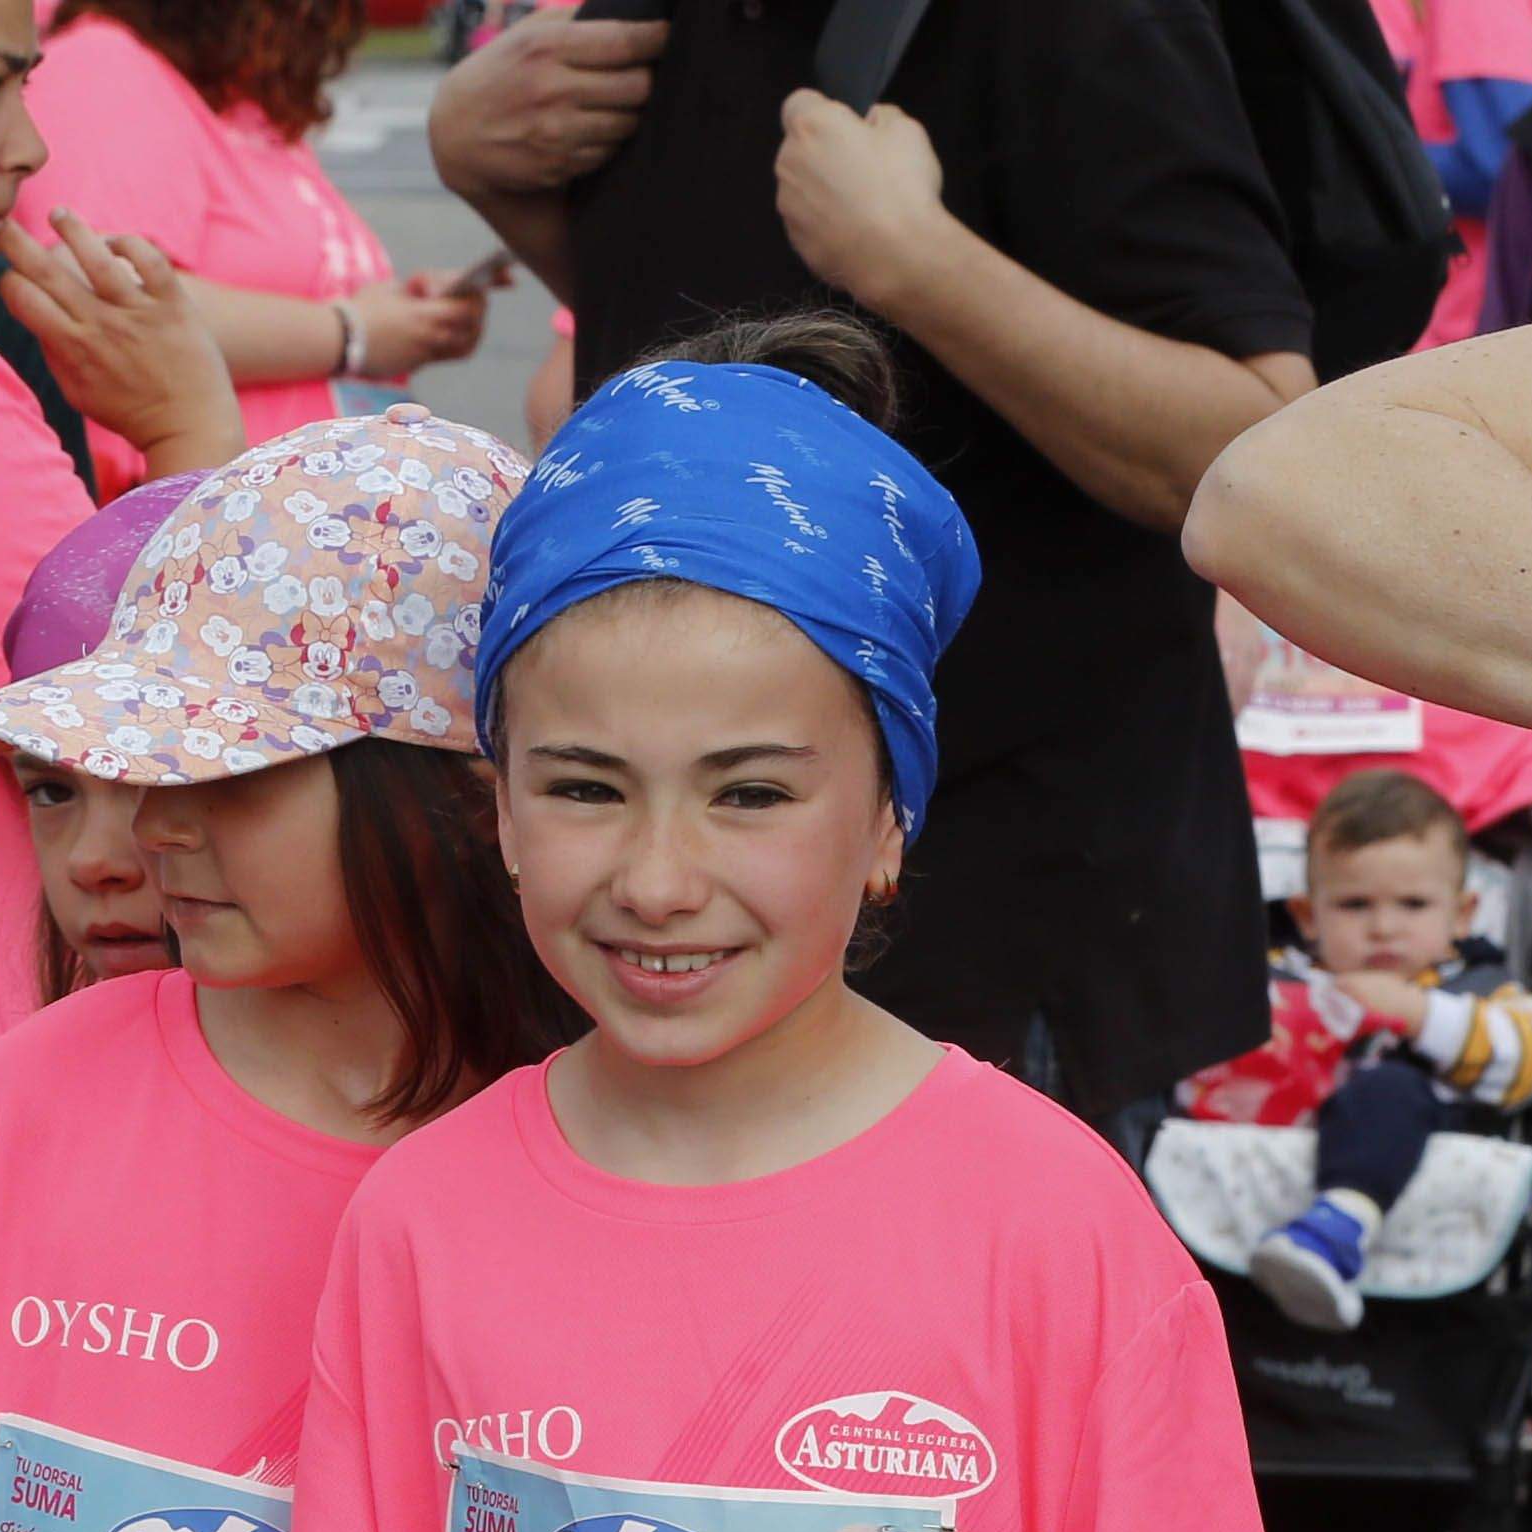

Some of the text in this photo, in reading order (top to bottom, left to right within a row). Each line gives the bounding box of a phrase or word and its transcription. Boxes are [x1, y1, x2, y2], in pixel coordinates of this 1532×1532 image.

[11, 1296, 218, 1371] OYSHO
[792, 1424, 980, 1484] ASTURIANA
[830, 1424, 976, 1450] CENTRAL LECHERA
[15, 1456, 83, 1492] TU DORSAL
[11, 1477, 75, 1521] SUMA
[482, 1490, 519, 1514] DORSAL
